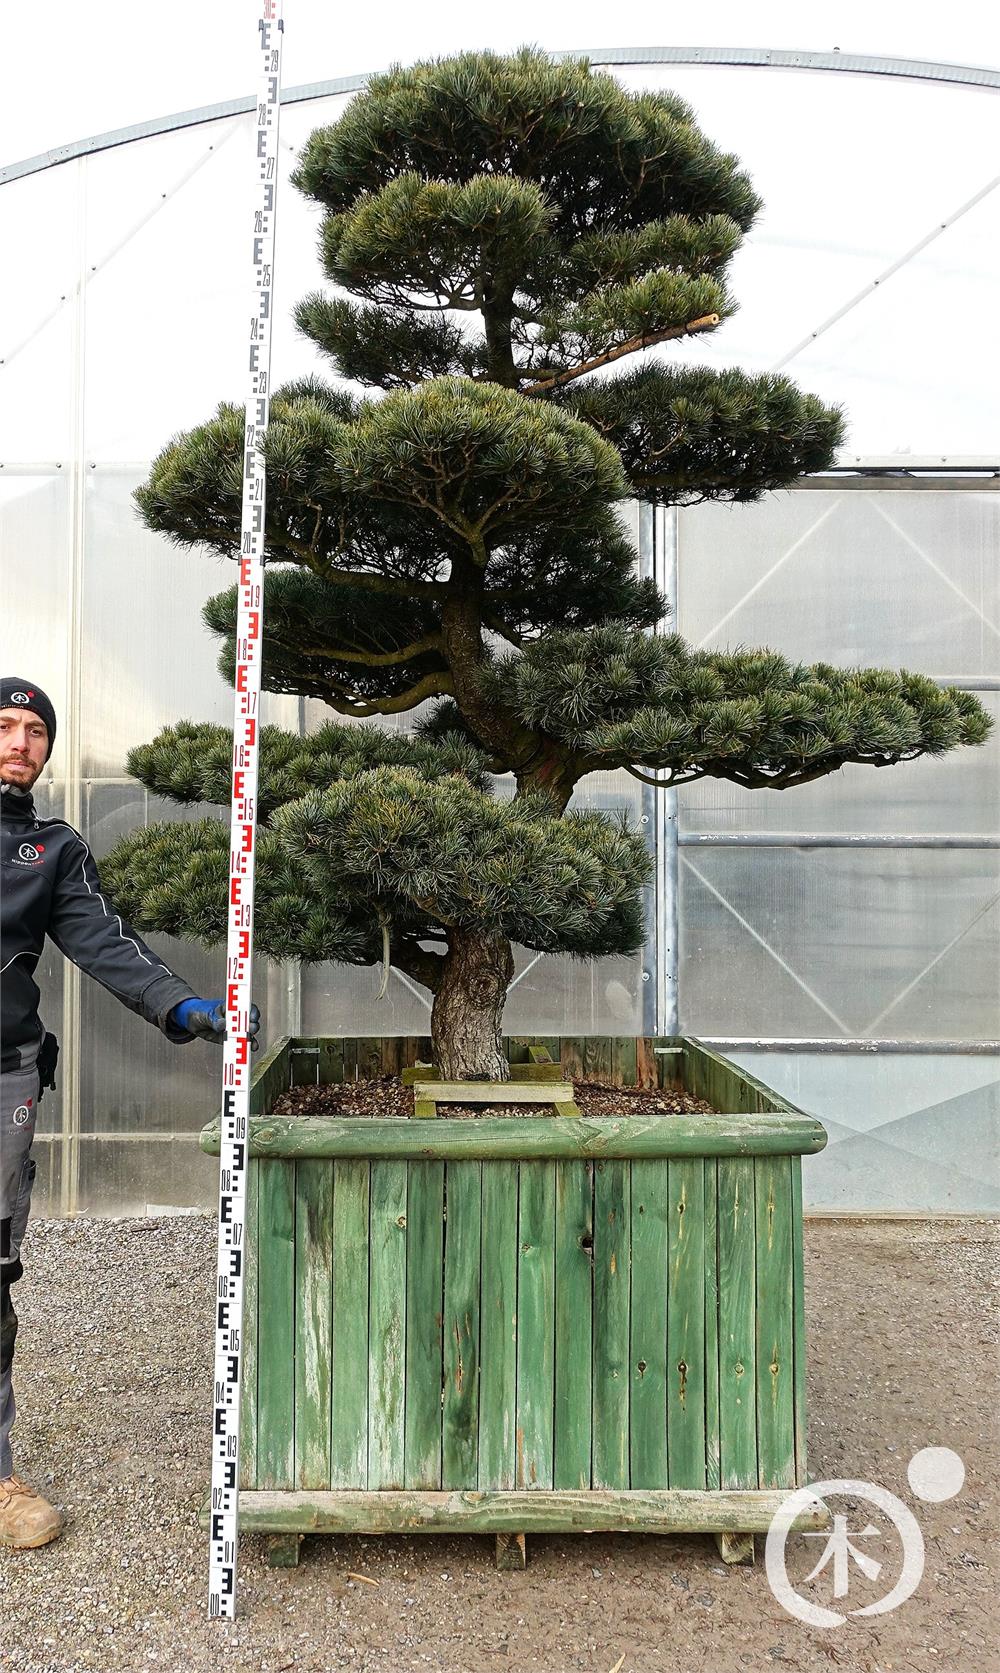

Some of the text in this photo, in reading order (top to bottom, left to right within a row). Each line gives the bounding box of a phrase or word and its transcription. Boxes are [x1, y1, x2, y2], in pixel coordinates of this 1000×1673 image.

[270, 50, 279, 72] 29
[266, 157, 275, 179] 27
[254, 211, 263, 233] 26
[262, 264, 271, 287] 25
[250, 317, 258, 340] 24
[258, 372, 267, 394] 23
[246, 425, 255, 447] 22
[255, 478, 263, 501] 21
[243, 531, 251, 554] 20
[250, 585, 260, 607] 19
[237, 638, 247, 660] 18
[247, 692, 257, 714] 17
[234, 745, 245, 767] 16
[243, 798, 254, 820] 15
[231, 851, 240, 873] 14
[240, 904, 250, 927] 13
[228, 957, 238, 979] 12
[237, 1010, 248, 1032] 11
[224, 1063, 234, 1085] 10
[235, 1117, 245, 1139] 09
[221, 1169, 231, 1192] 08
[233, 1223, 243, 1245] 07
[218, 1275, 228, 1298] 06
[230, 1329, 240, 1351] 05
[215, 1381, 225, 1404] 04
[227, 1435, 237, 1457] 03
[212, 1487, 222, 1509] 02
[224, 1541, 234, 1563] 01
[210, 1593, 220, 1616] 00
